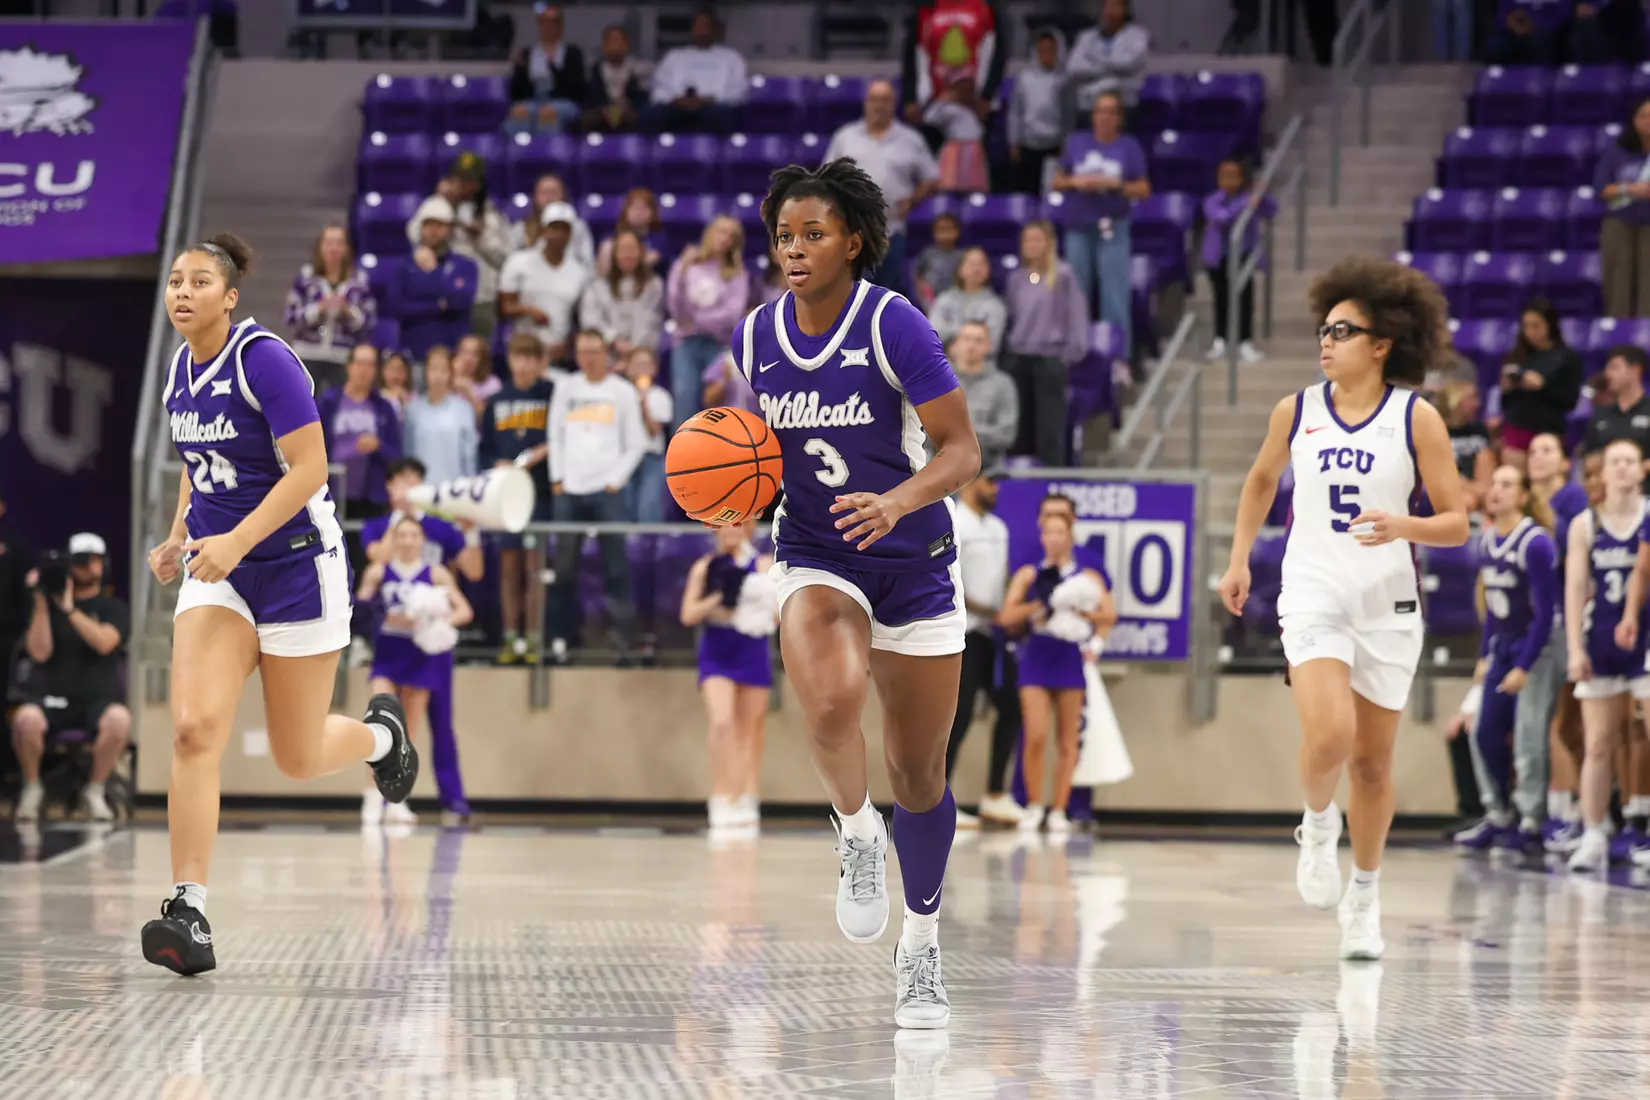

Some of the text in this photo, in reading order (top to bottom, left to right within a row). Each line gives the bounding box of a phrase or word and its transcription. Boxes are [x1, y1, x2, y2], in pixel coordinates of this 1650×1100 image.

[0, 341, 114, 476] U
[170, 410, 239, 443] Wildcats
[759, 390, 876, 430] Wildcats
[183, 449, 238, 493] 24
[803, 438, 850, 488] 3
[1318, 447, 1375, 475] TCU
[1329, 484, 1362, 533] 5
